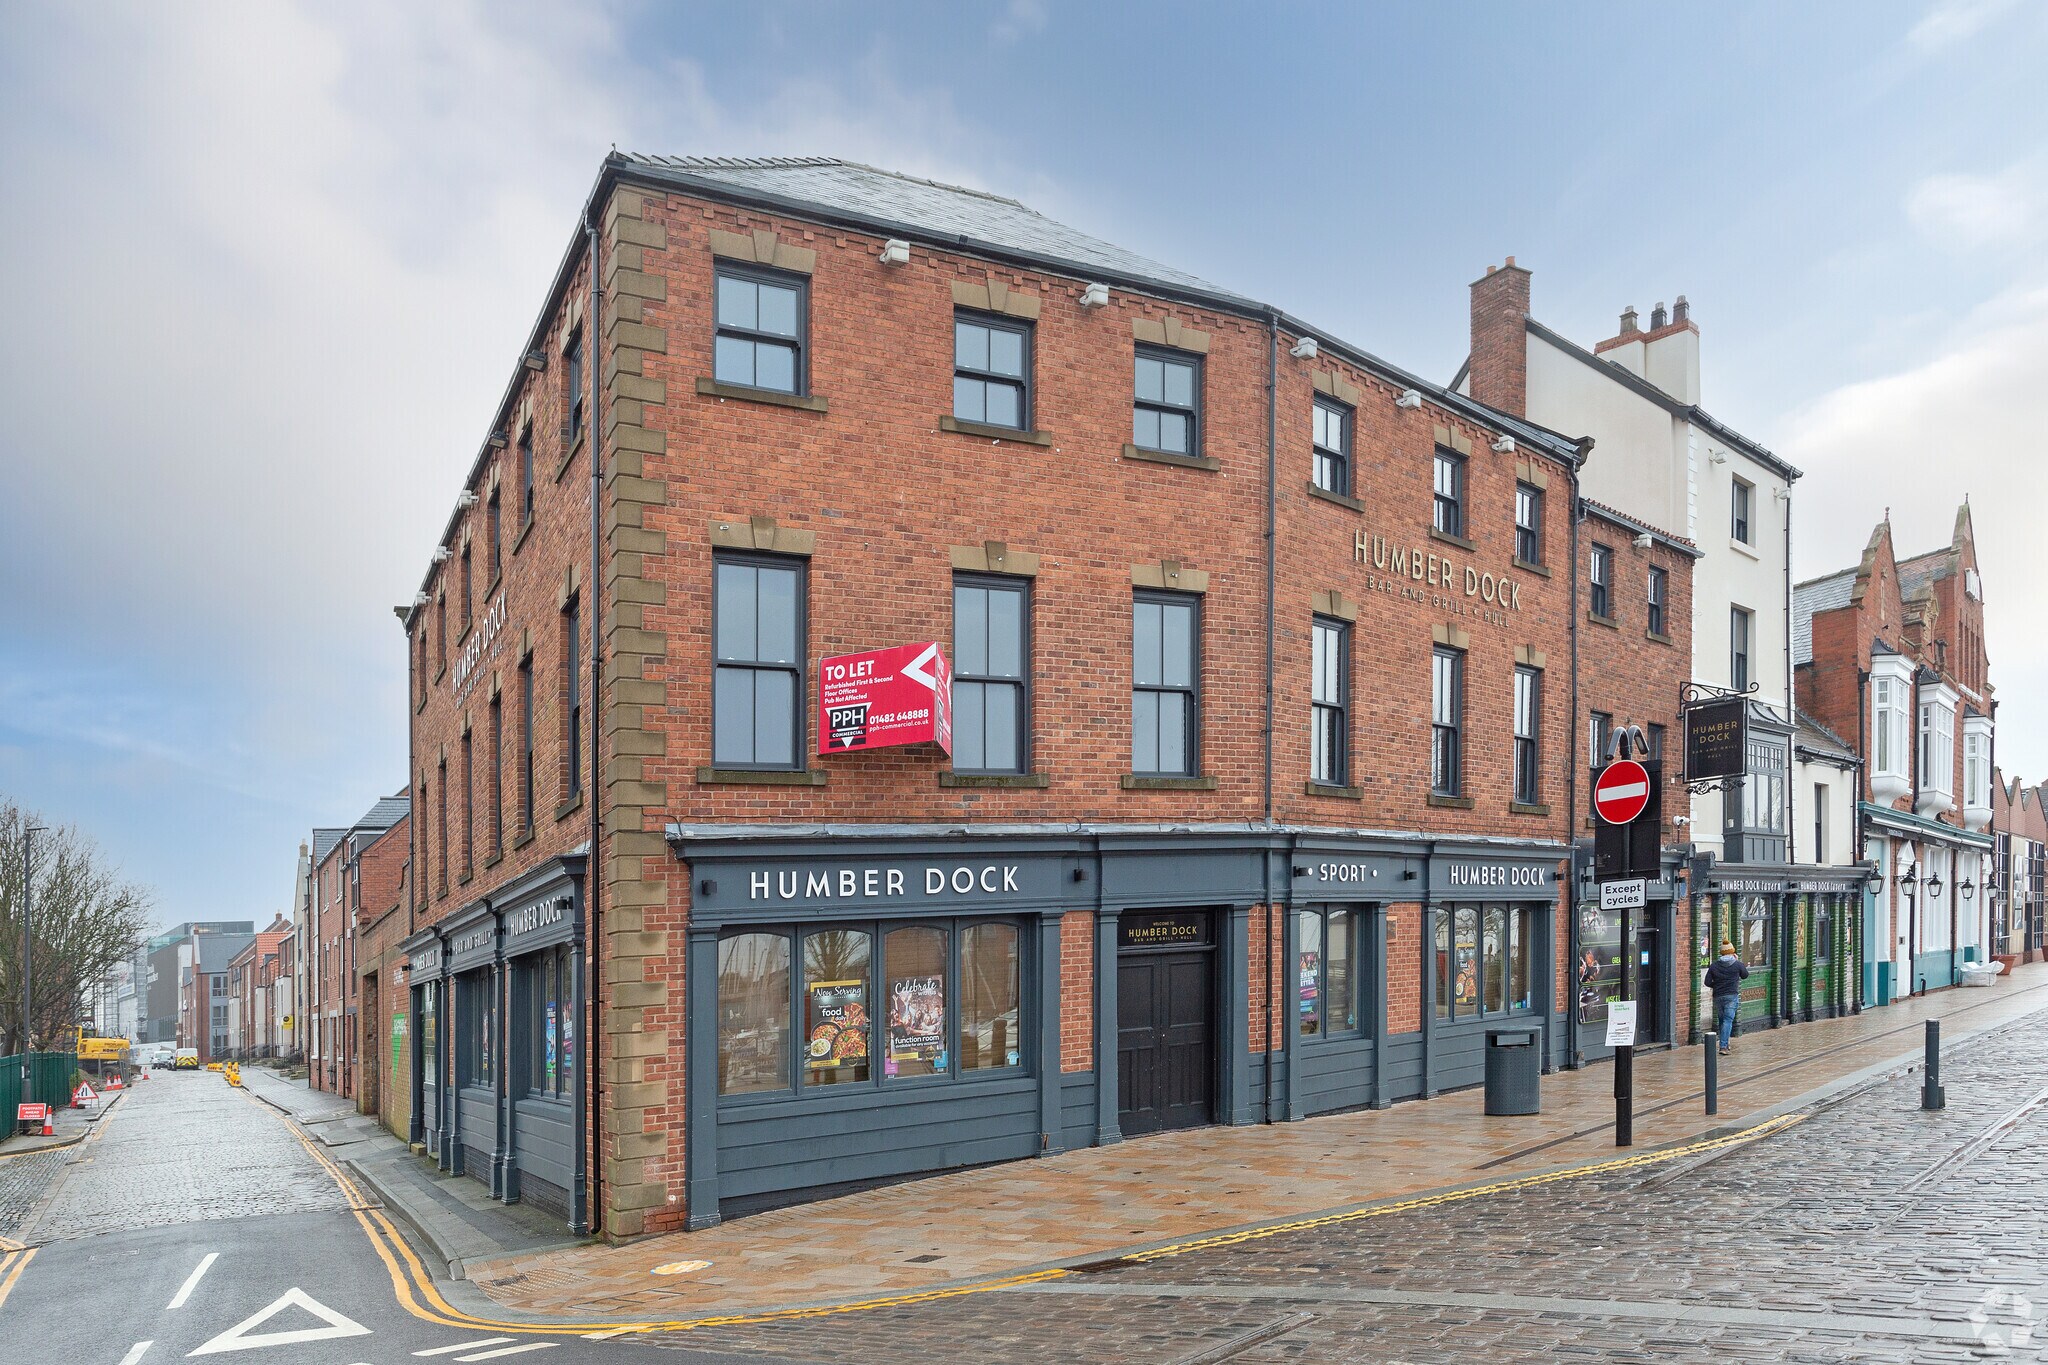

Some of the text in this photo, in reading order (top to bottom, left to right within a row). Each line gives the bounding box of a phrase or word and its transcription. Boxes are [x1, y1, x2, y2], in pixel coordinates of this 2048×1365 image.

[1353, 528, 1521, 611] HUMBER DOCK
[1368, 575, 1510, 627] BAR AND GRILL HULL
[452, 588, 507, 695] HUMBER DOCK
[825, 660, 875, 681] TO LET
[824, 681, 856, 690] Refurbished
[873, 674, 894, 684] Second
[844, 693, 868, 702] Affected
[832, 708, 864, 728] PPH
[869, 708, 929, 725] 01482 648888
[869, 718, 929, 733] pph-commercial.co.uk
[1692, 721, 1738, 735] HUMBER
[831, 730, 864, 738] COMMERCIAL
[1699, 732, 1730, 744] DOCK
[1319, 863, 1368, 883] SPORT
[1450, 864, 1546, 886] HUMBER DOCK
[750, 866, 1019, 900] HUMBER DOCK
[1605, 883, 1642, 895] Except
[1721, 880, 1781, 891] HUMBER DOCK tavern
[1800, 881, 1818, 891] HUMBER
[1818, 881, 1830, 891] DOCK
[1606, 894, 1639, 906] cycles
[510, 905, 537, 937] HUMBER
[1128, 925, 1198, 937] HUMBER DOCK
[814, 986, 862, 998] Now Serving
[894, 977, 937, 995] Celebrate
[822, 1007, 842, 1017] food
[894, 1035, 922, 1045] function
